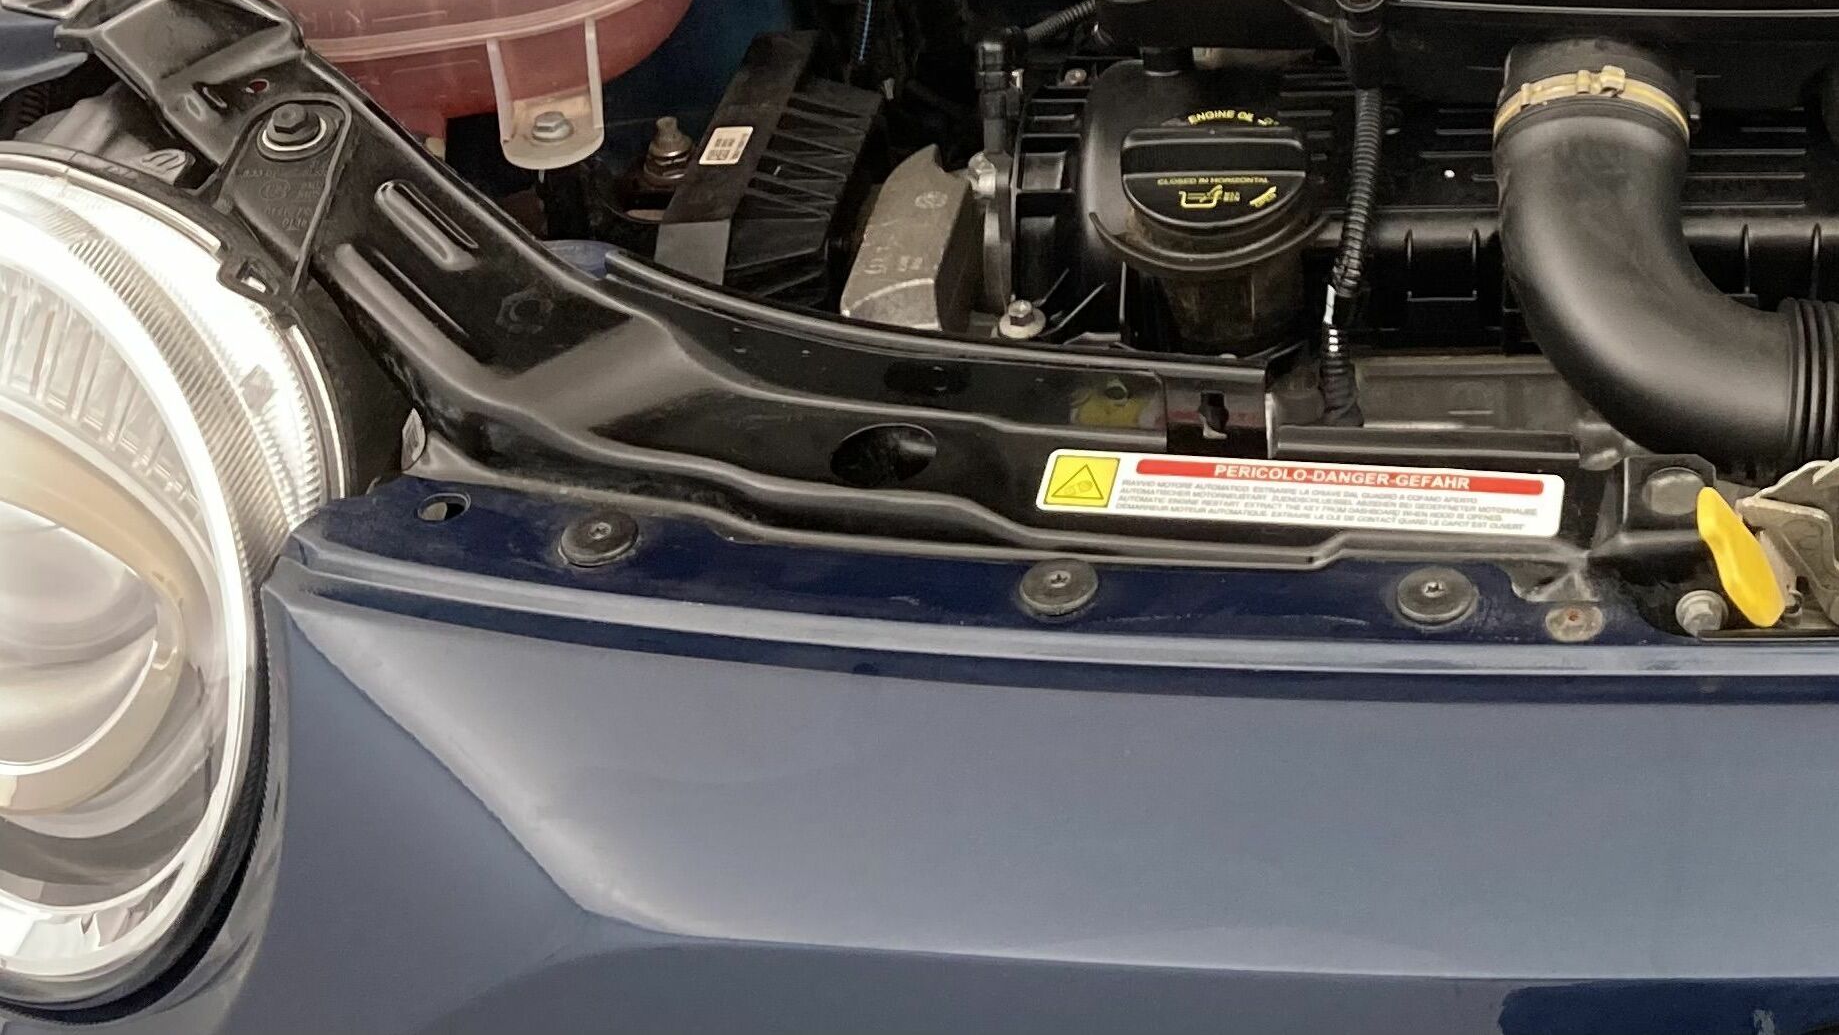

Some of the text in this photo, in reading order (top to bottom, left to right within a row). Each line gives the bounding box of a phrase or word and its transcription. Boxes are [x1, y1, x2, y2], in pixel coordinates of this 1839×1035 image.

[1187, 110, 1235, 125] ENGINE
[1157, 177, 1197, 185] CLOSED
[1210, 176, 1269, 184] HORIZONTAL
[1214, 463, 1471, 490] PERICOLO-DANGER-GEFAHR
[1348, 507, 1400, 516] DASHBOARD
